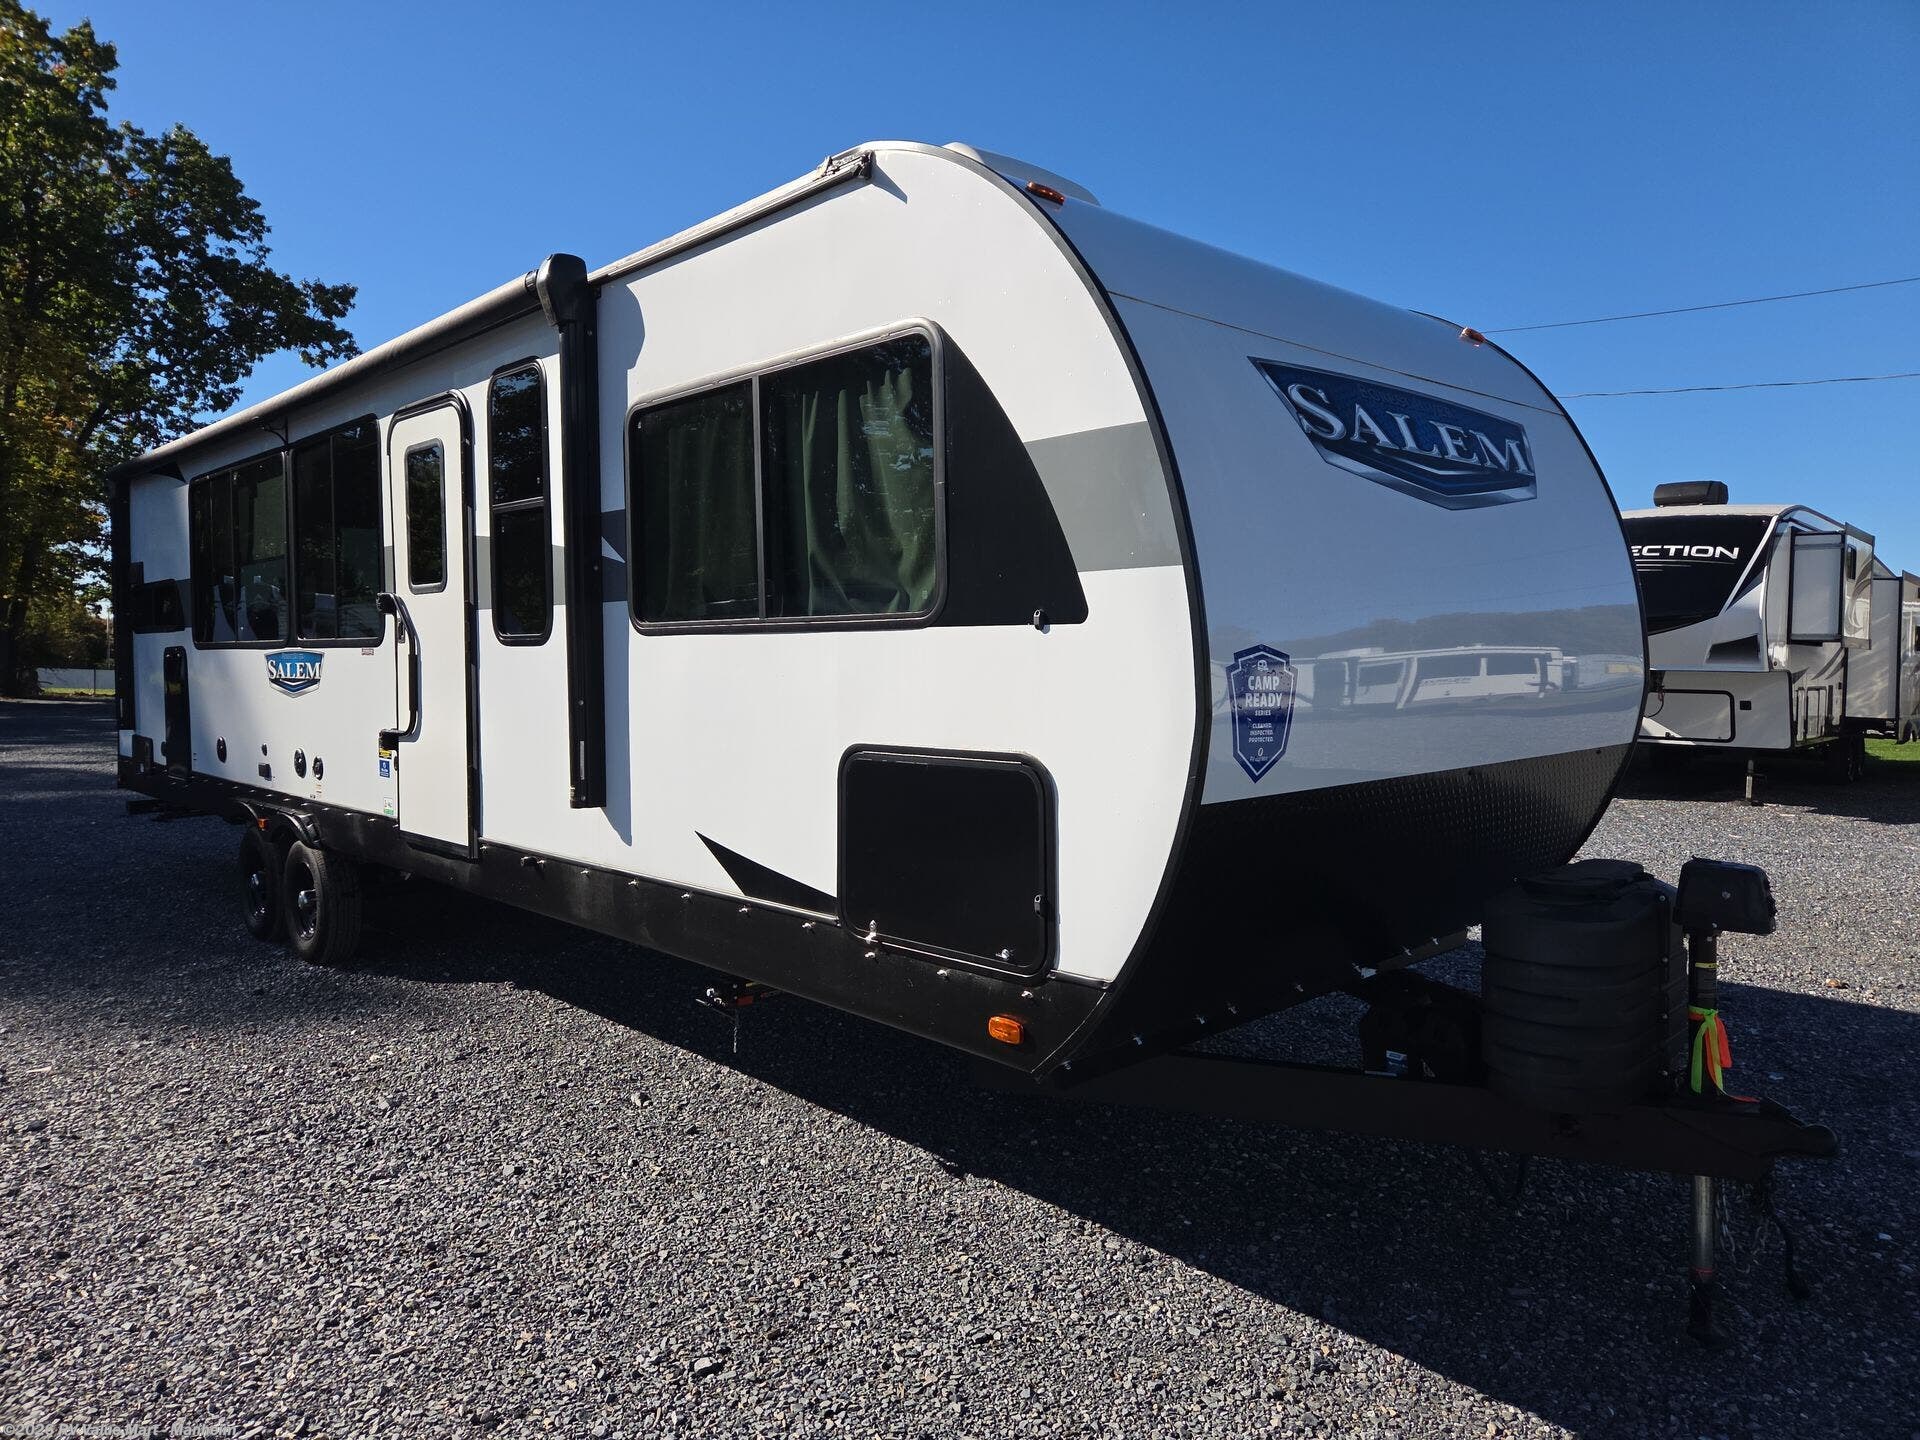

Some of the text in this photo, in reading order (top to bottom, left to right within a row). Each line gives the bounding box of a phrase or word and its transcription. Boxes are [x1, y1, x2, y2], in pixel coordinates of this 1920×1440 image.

[1287, 383, 1535, 475] SALEM
[268, 660, 321, 679] SALEM
[1248, 676, 1280, 690] CAMP
[1245, 693, 1283, 707] READY
